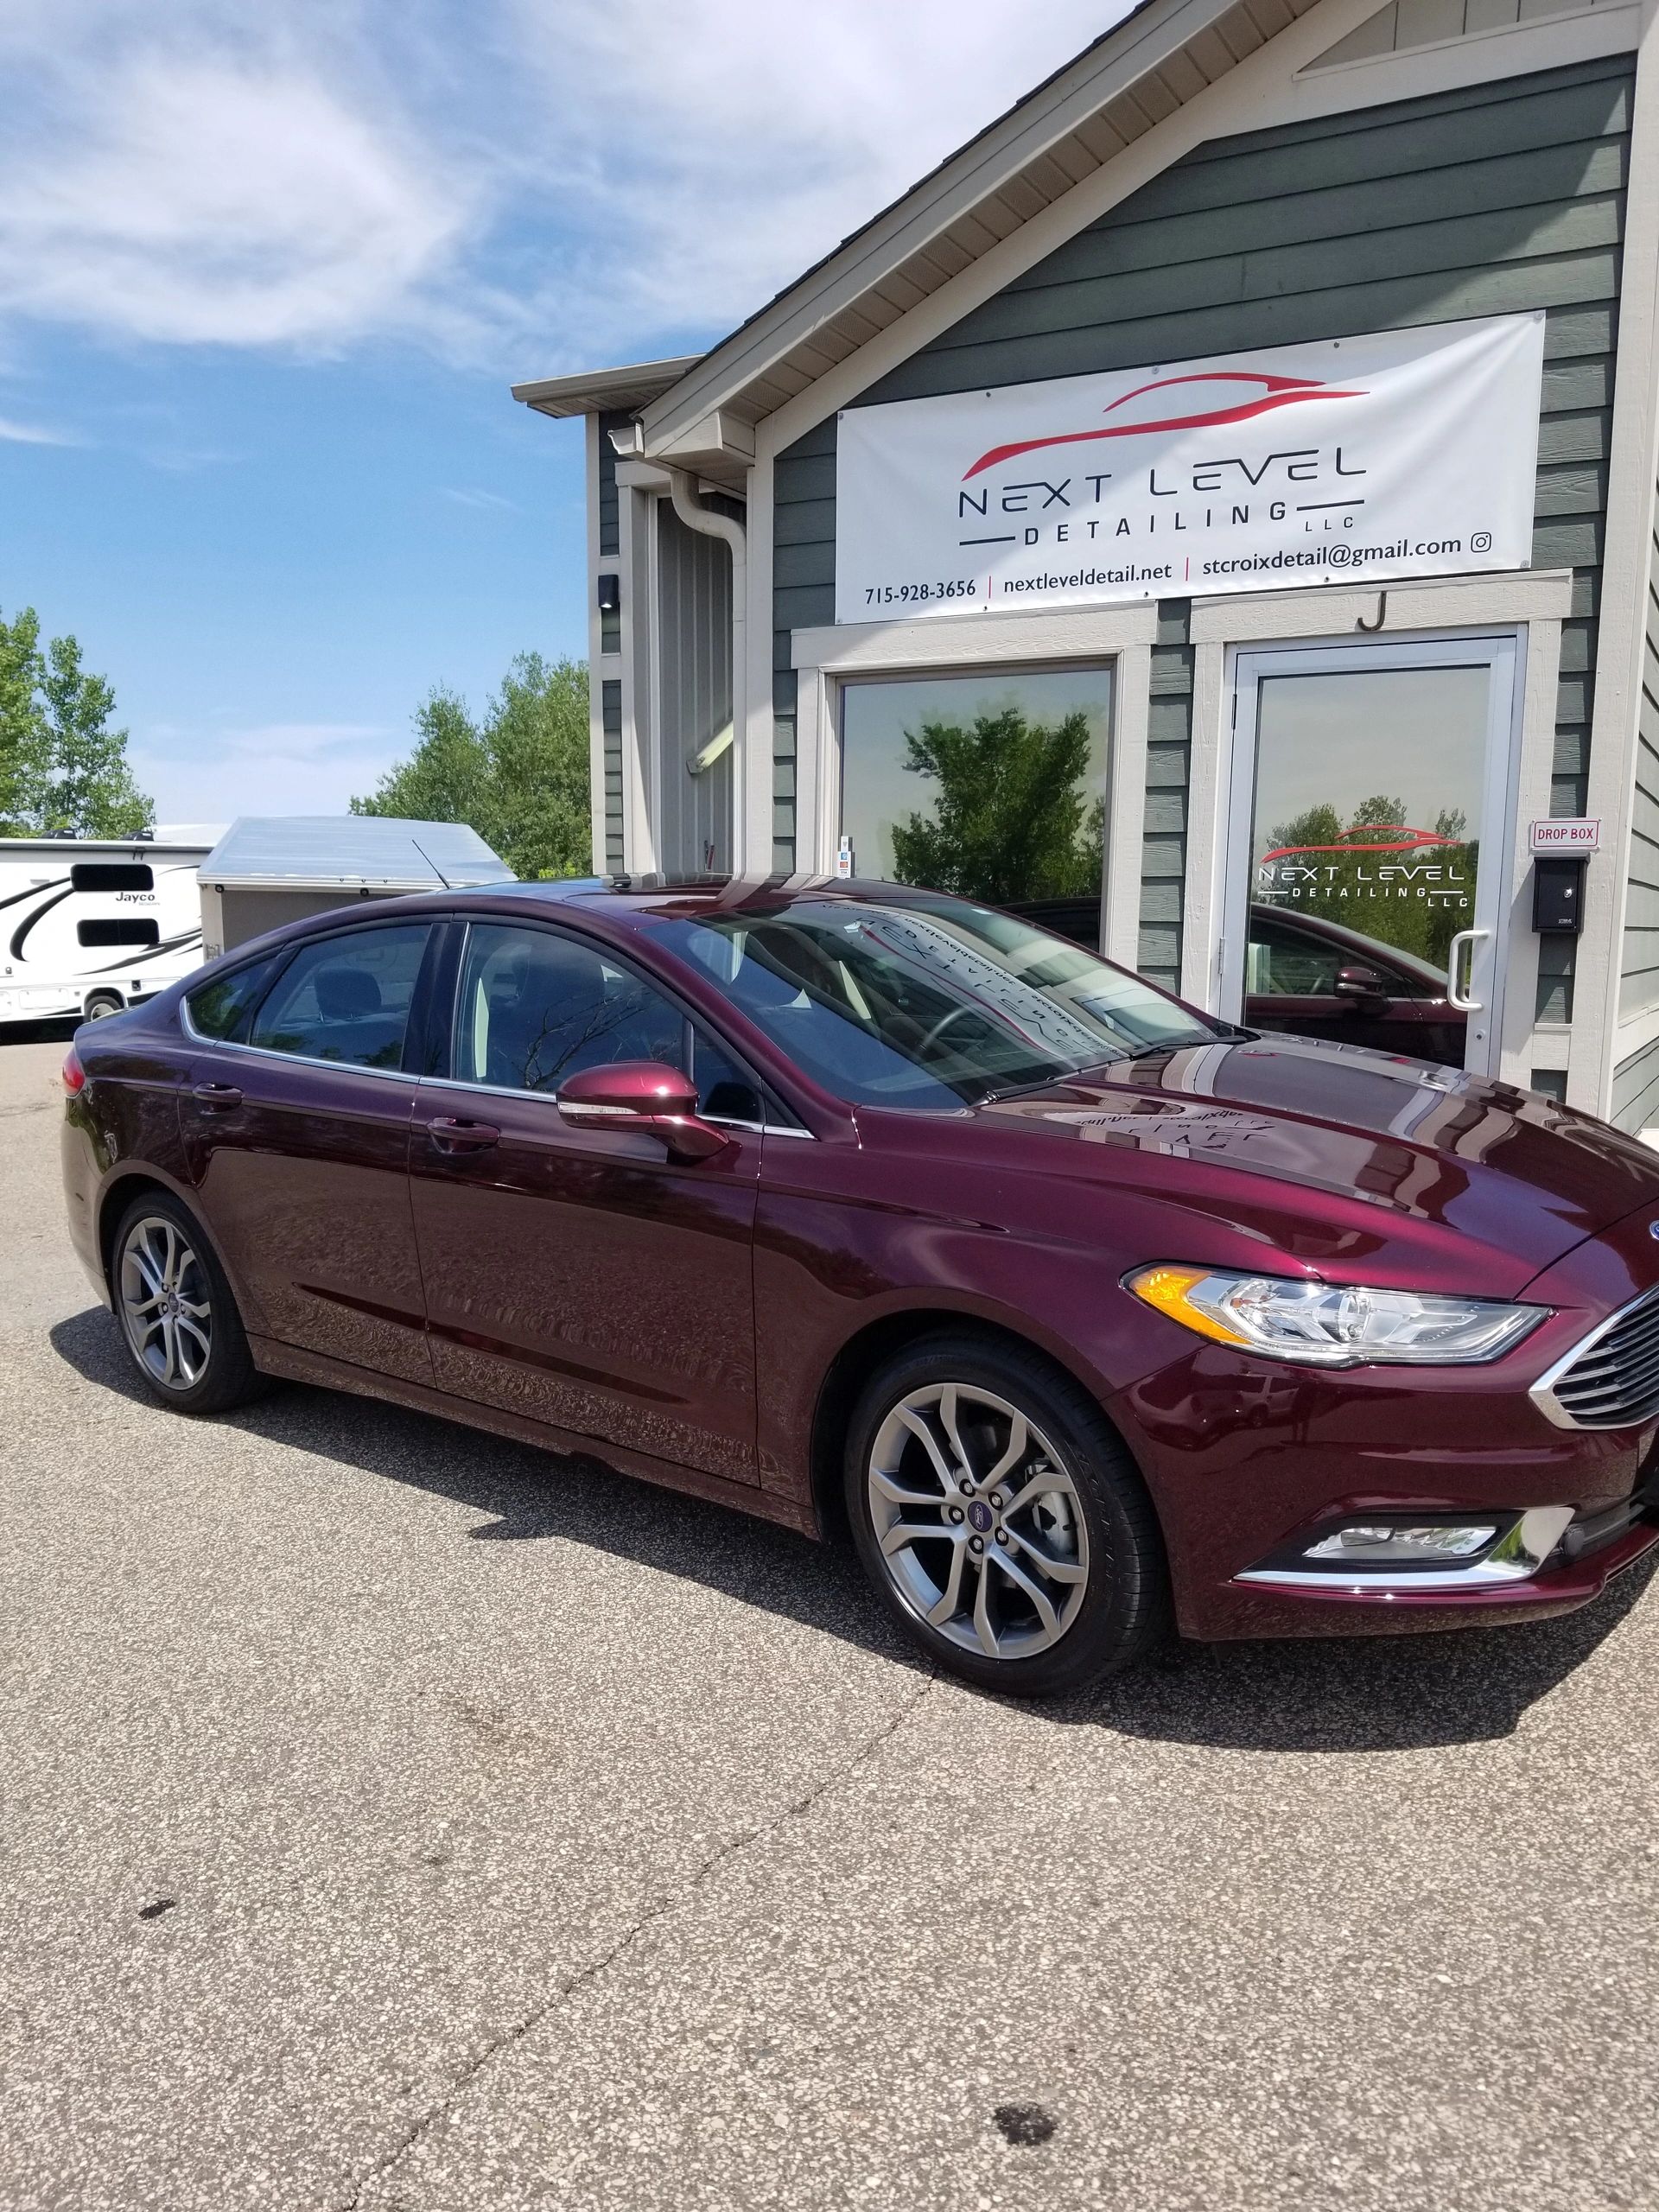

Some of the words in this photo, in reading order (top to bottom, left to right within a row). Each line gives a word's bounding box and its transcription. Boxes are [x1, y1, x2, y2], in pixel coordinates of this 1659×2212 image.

[959, 474, 1112, 518] NEXT
[1150, 447, 1367, 495] LEVEL
[1025, 501, 1286, 545] DETAILING
[1305, 517, 1353, 531] LLC
[865, 580, 976, 604] 715-928-3656
[1004, 564, 1172, 593] nextleveldetail.net
[1203, 539, 1461, 575] stcroixdetail@gmail.com
[1357, 591, 1387, 632] J
[1538, 829, 1567, 840] DROP
[1570, 828, 1594, 839] BOX
[1259, 867, 1338, 880] NEXT
[1357, 867, 1465, 880] LEVEL
[116, 891, 156, 904] Jayco
[1293, 887, 1426, 897] DETAILING
[1427, 898, 1468, 907] LLC
